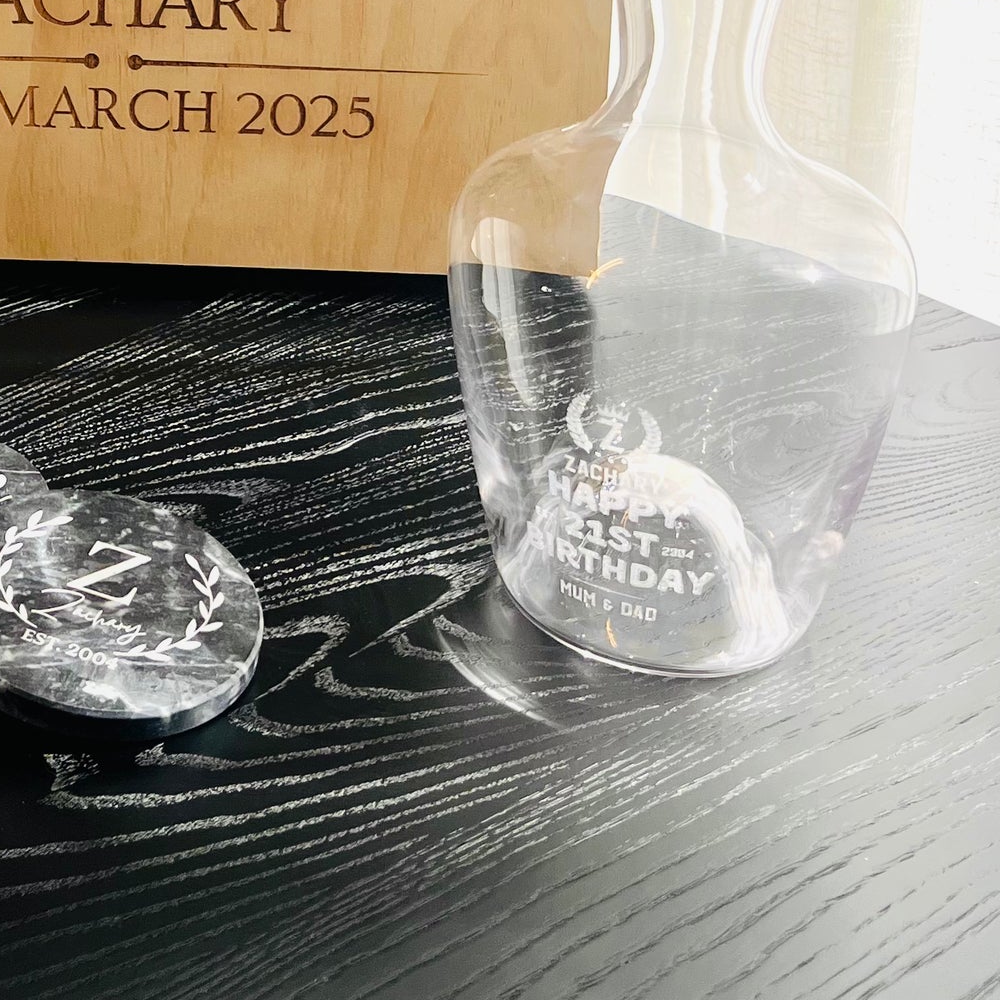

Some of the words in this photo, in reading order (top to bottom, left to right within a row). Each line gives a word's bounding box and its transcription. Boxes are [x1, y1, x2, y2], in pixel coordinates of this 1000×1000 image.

[234, 92, 378, 140] 2025
[547, 469, 691, 530] HAPPY
[526, 519, 716, 597] BIRTHDAY
[563, 510, 661, 559] 21ST
[66, 540, 153, 607] Z
[559, 578, 597, 609] MUM
[602, 598, 614, 612] &
[620, 601, 658, 622] DAD
[20, 628, 61, 653] EST.
[64, 643, 119, 671] 2004
